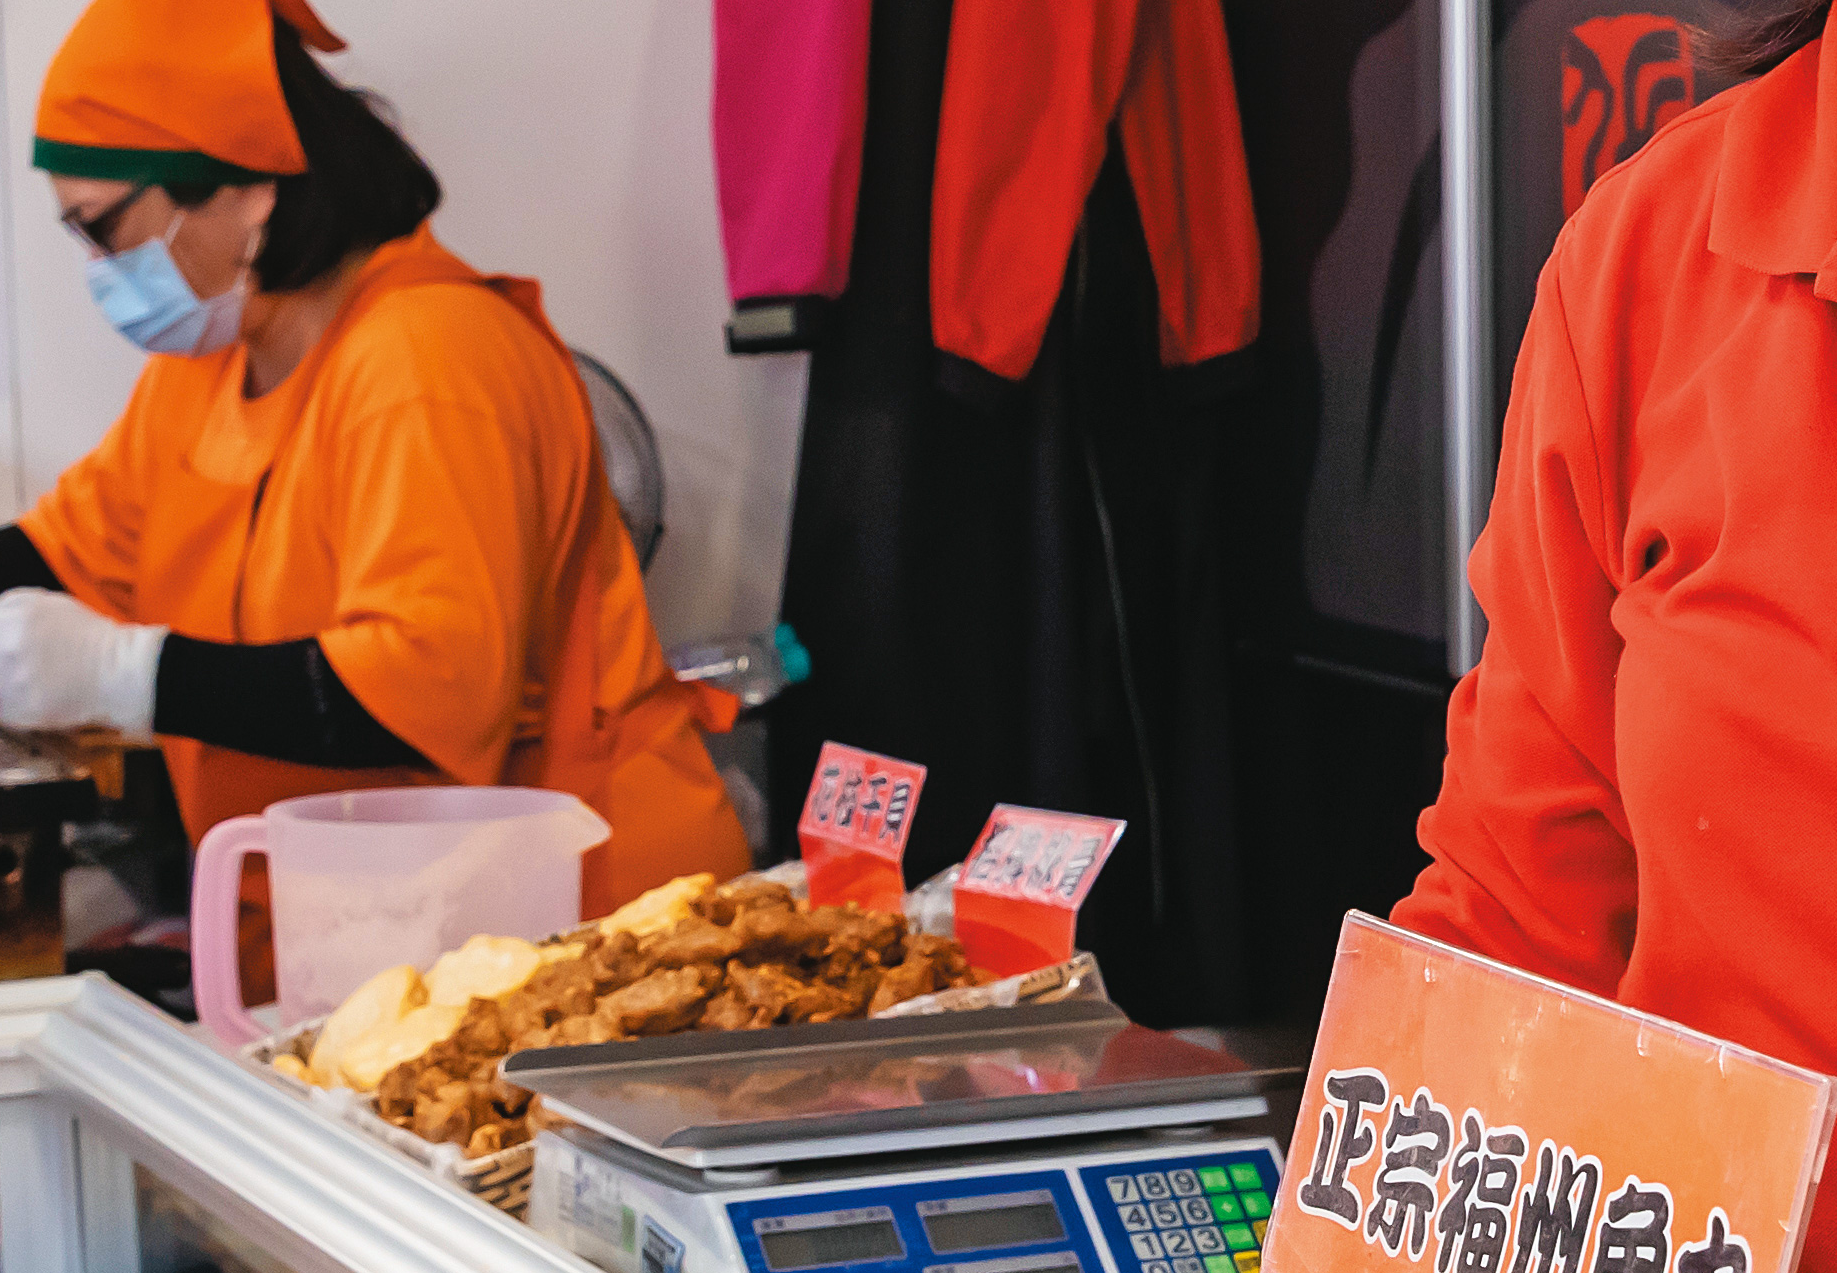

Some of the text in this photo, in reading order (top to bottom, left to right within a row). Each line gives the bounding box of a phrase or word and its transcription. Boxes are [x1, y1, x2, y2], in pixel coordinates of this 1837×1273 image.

[1111, 1179, 1130, 1200] 7
[1146, 1175, 1165, 1195] 8
[1176, 1171, 1196, 1193] 9
[1127, 1208, 1146, 1227] 4
[1156, 1204, 1177, 1224] 5
[1186, 1200, 1209, 1221] 6
[1140, 1235, 1156, 1256] 1
[1168, 1233, 1190, 1254] 2
[1197, 1229, 1220, 1250] 3
